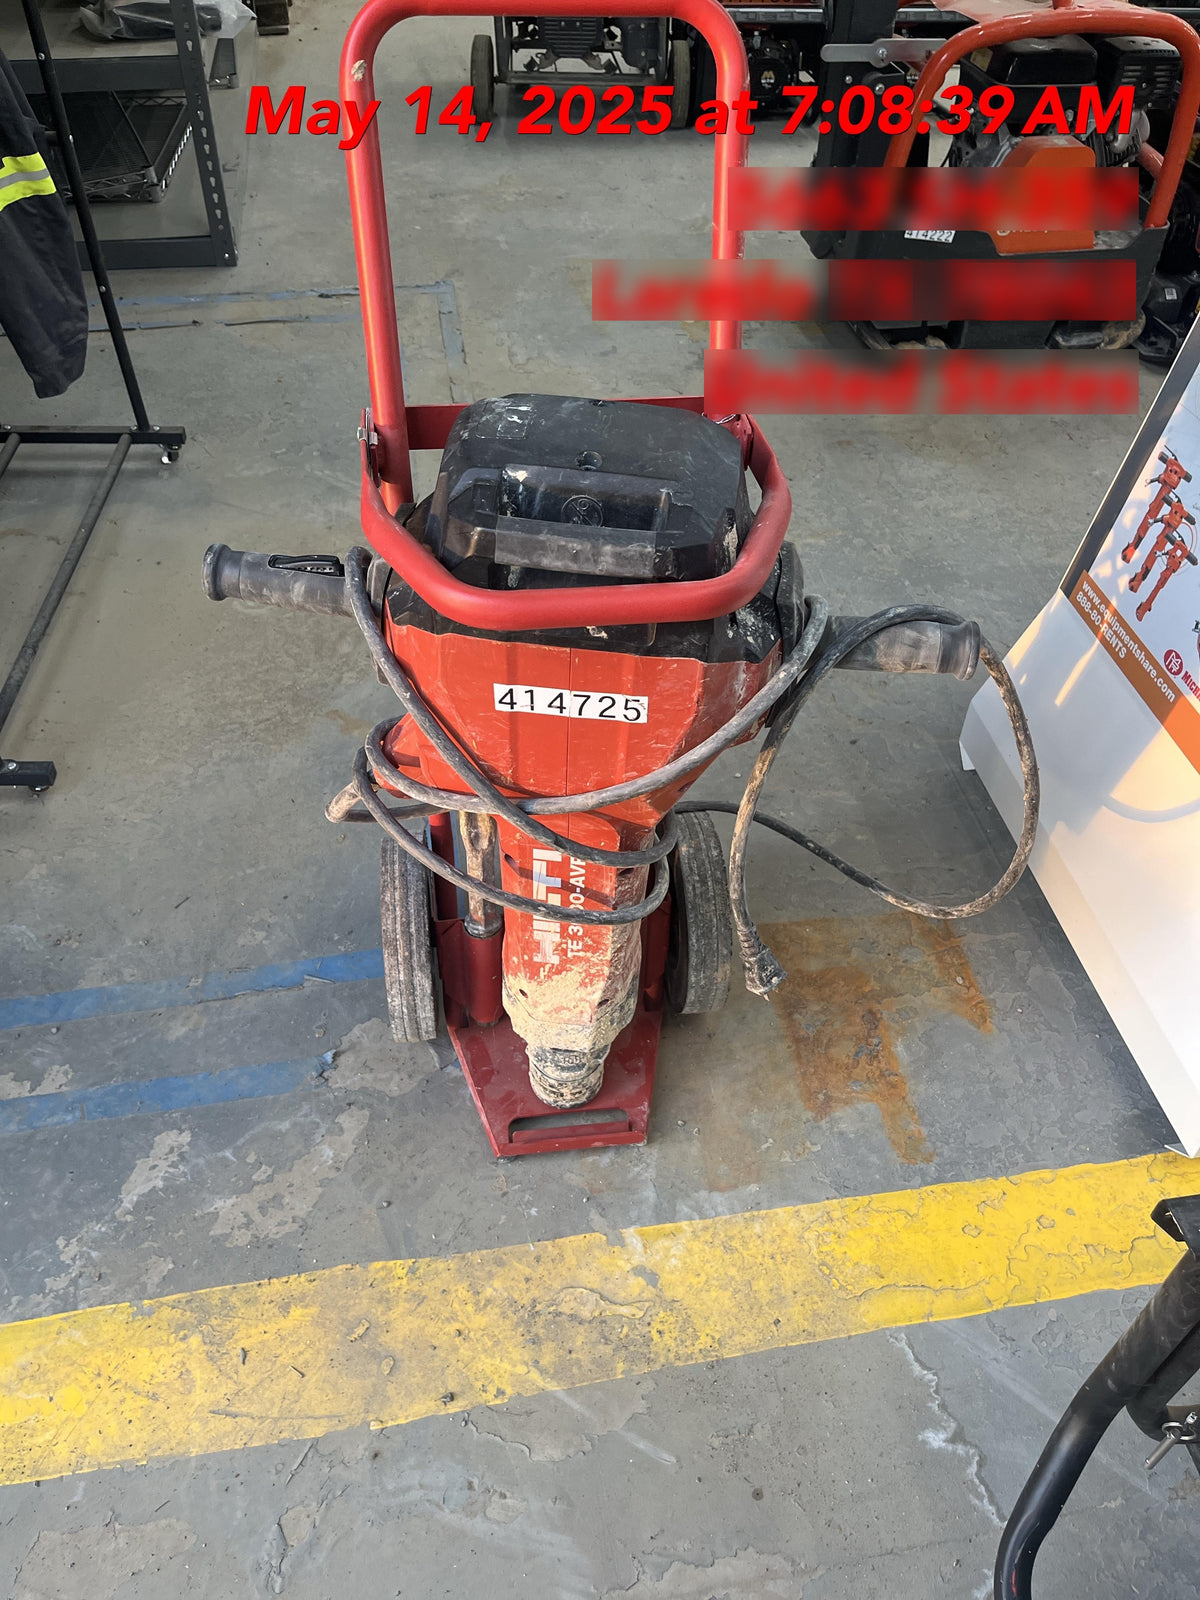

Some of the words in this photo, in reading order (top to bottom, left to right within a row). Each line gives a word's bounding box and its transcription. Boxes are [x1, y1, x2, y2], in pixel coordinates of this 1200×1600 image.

[1076, 591, 1127, 659] 888-80-RENTS
[1081, 581, 1176, 703] www.equipmentshare.com
[498, 687, 642, 722] 414725
[567, 856, 587, 936] 30-AV
[567, 939, 584, 958] TE
